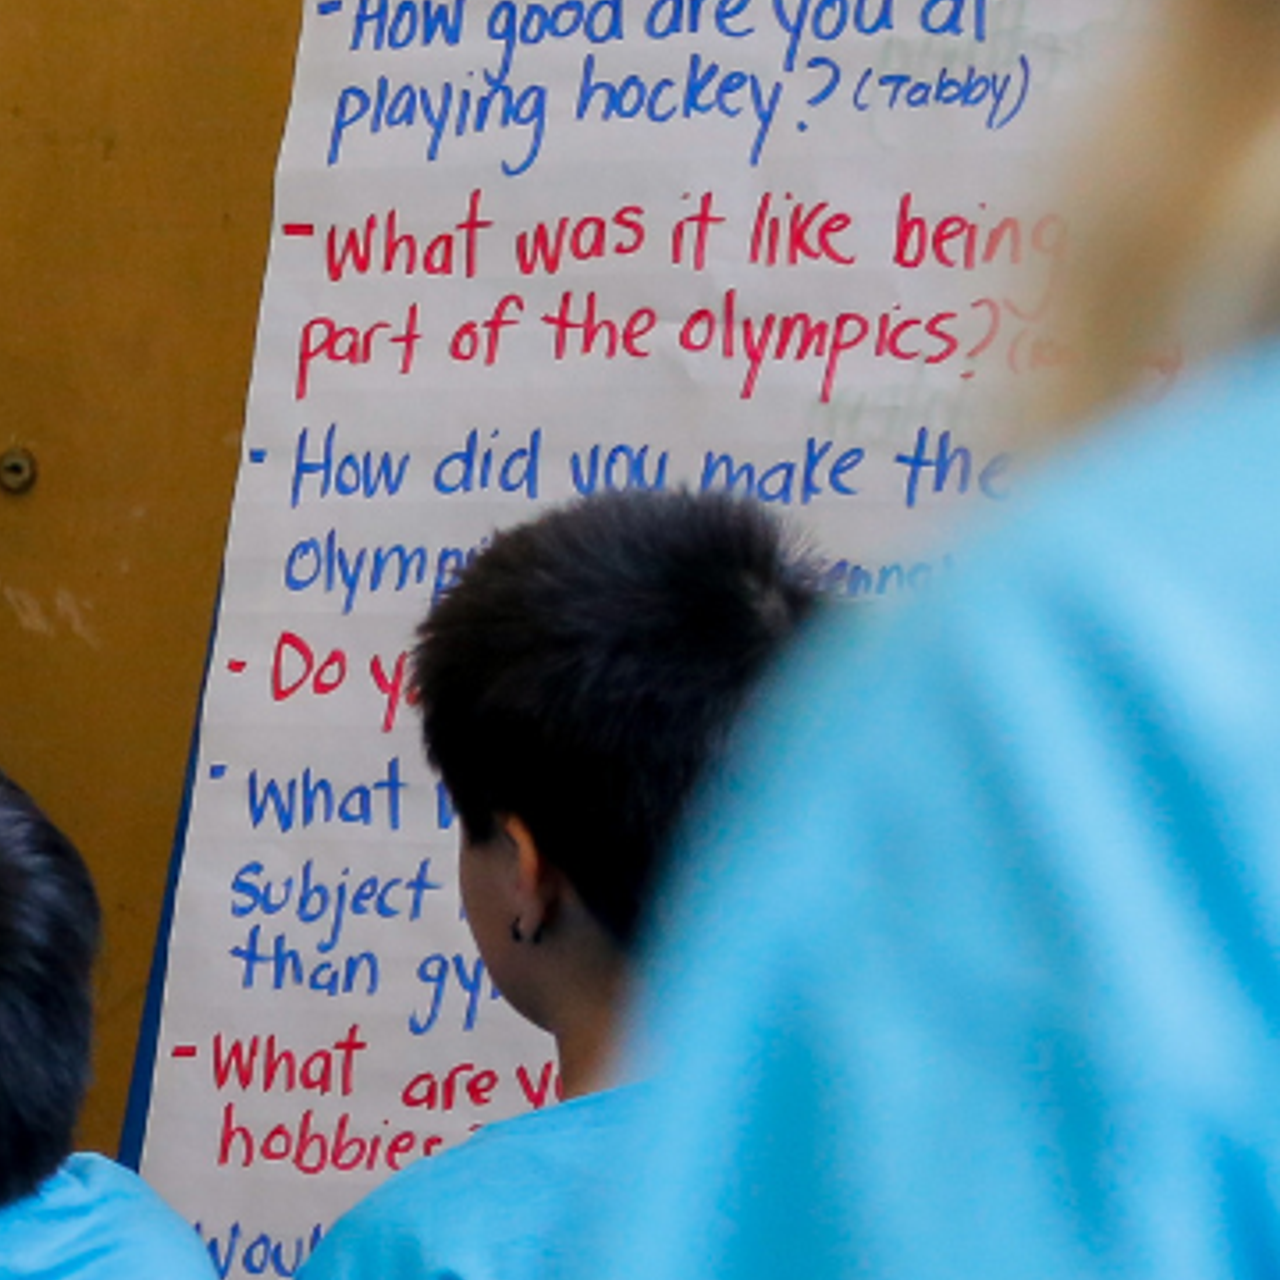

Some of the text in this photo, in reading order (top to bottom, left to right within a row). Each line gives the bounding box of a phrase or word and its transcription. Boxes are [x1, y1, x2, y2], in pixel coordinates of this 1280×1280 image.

[326, 54, 1033, 176] playing hockey? (Tabby)
[514, 203, 646, 276] was
[671, 191, 726, 272] it
[746, 191, 857, 268] like
[294, 302, 424, 402] part
[448, 293, 525, 367] of
[542, 290, 659, 363] the
[432, 426, 542, 500] did
[699, 437, 866, 506] make
[894, 426, 1013, 509] the
[229, 923, 379, 998] than
[400, 1061, 499, 1112] are
